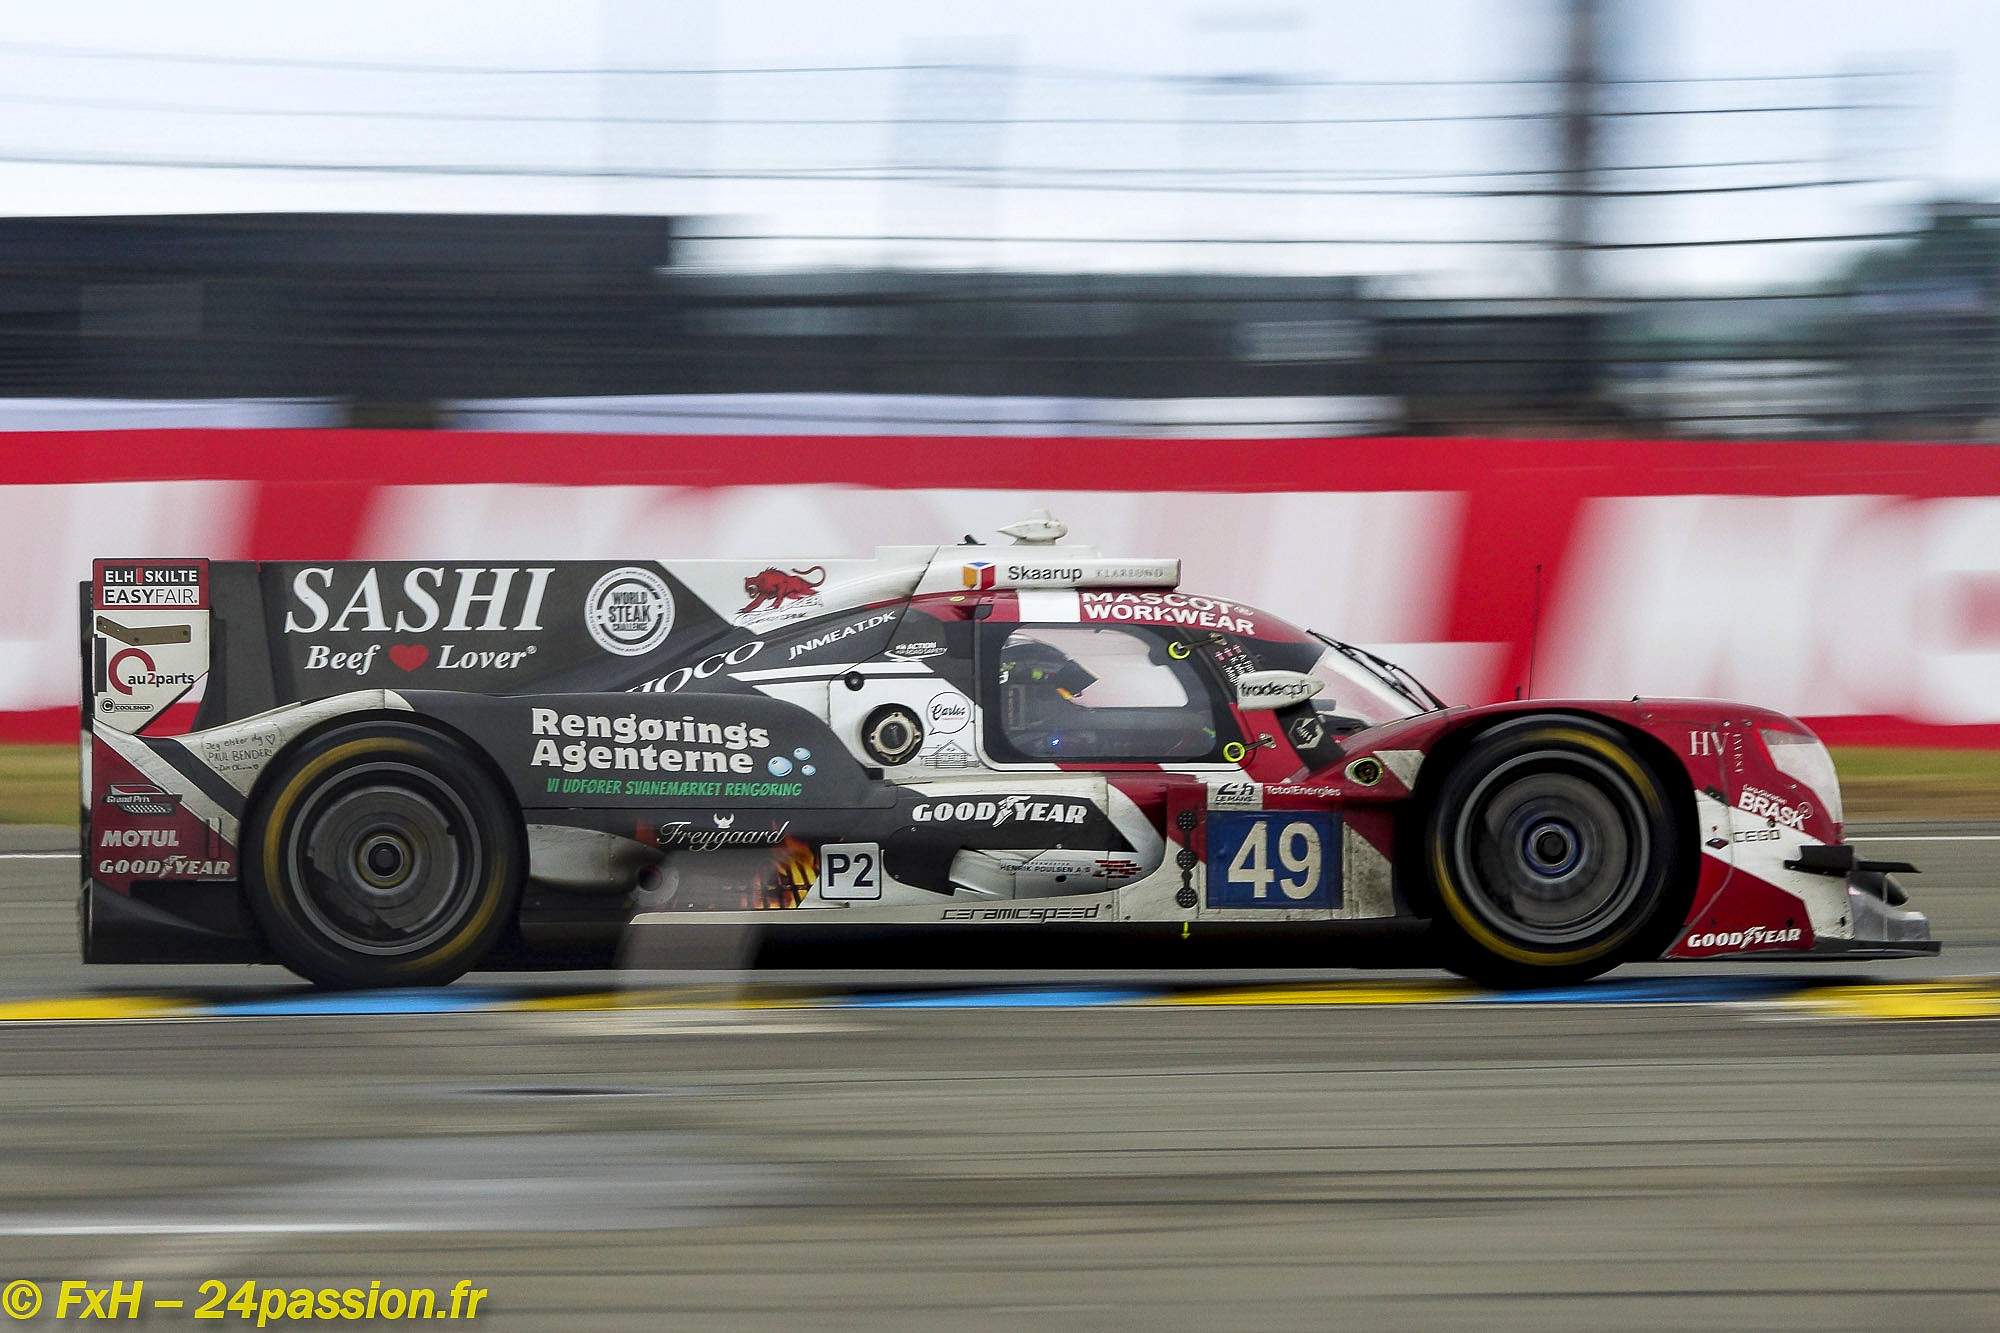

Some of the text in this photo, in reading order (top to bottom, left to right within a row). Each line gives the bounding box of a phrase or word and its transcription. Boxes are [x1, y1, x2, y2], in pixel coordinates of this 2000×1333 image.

[104, 569, 198, 583] ELH SKILTE
[1007, 565, 1083, 583] Skaarup
[284, 566, 556, 634] SASHI
[612, 592, 648, 605] WORLD
[608, 605, 651, 623] STEAK
[1082, 604, 1255, 635] WORKWEAR
[907, 641, 937, 650] ACTION
[304, 644, 382, 675] Beef
[128, 672, 194, 688] au2parts
[1240, 678, 1312, 699] tradecph
[114, 704, 151, 712] COOLSHOP
[531, 707, 770, 749] Rengørings
[1688, 731, 1730, 757] HV
[530, 738, 755, 774] Agenterne
[546, 777, 560, 793] VI
[562, 778, 621, 795] UDFØRER
[723, 781, 802, 797] RENGØRING
[1265, 785, 1341, 798] TotalEnergies
[106, 795, 150, 803] Grand Prix
[1738, 791, 1806, 831] BRASK
[100, 830, 180, 847] MOTUL
[655, 820, 791, 852] Freygaard
[1733, 829, 1780, 843] CEGO
[827, 852, 874, 888] P2
[1000, 864, 1032, 872] HENRIK
[1034, 865, 1074, 873] POULSEN
[1228, 820, 1322, 900] 49
[940, 903, 1100, 924] ceramicspeed
